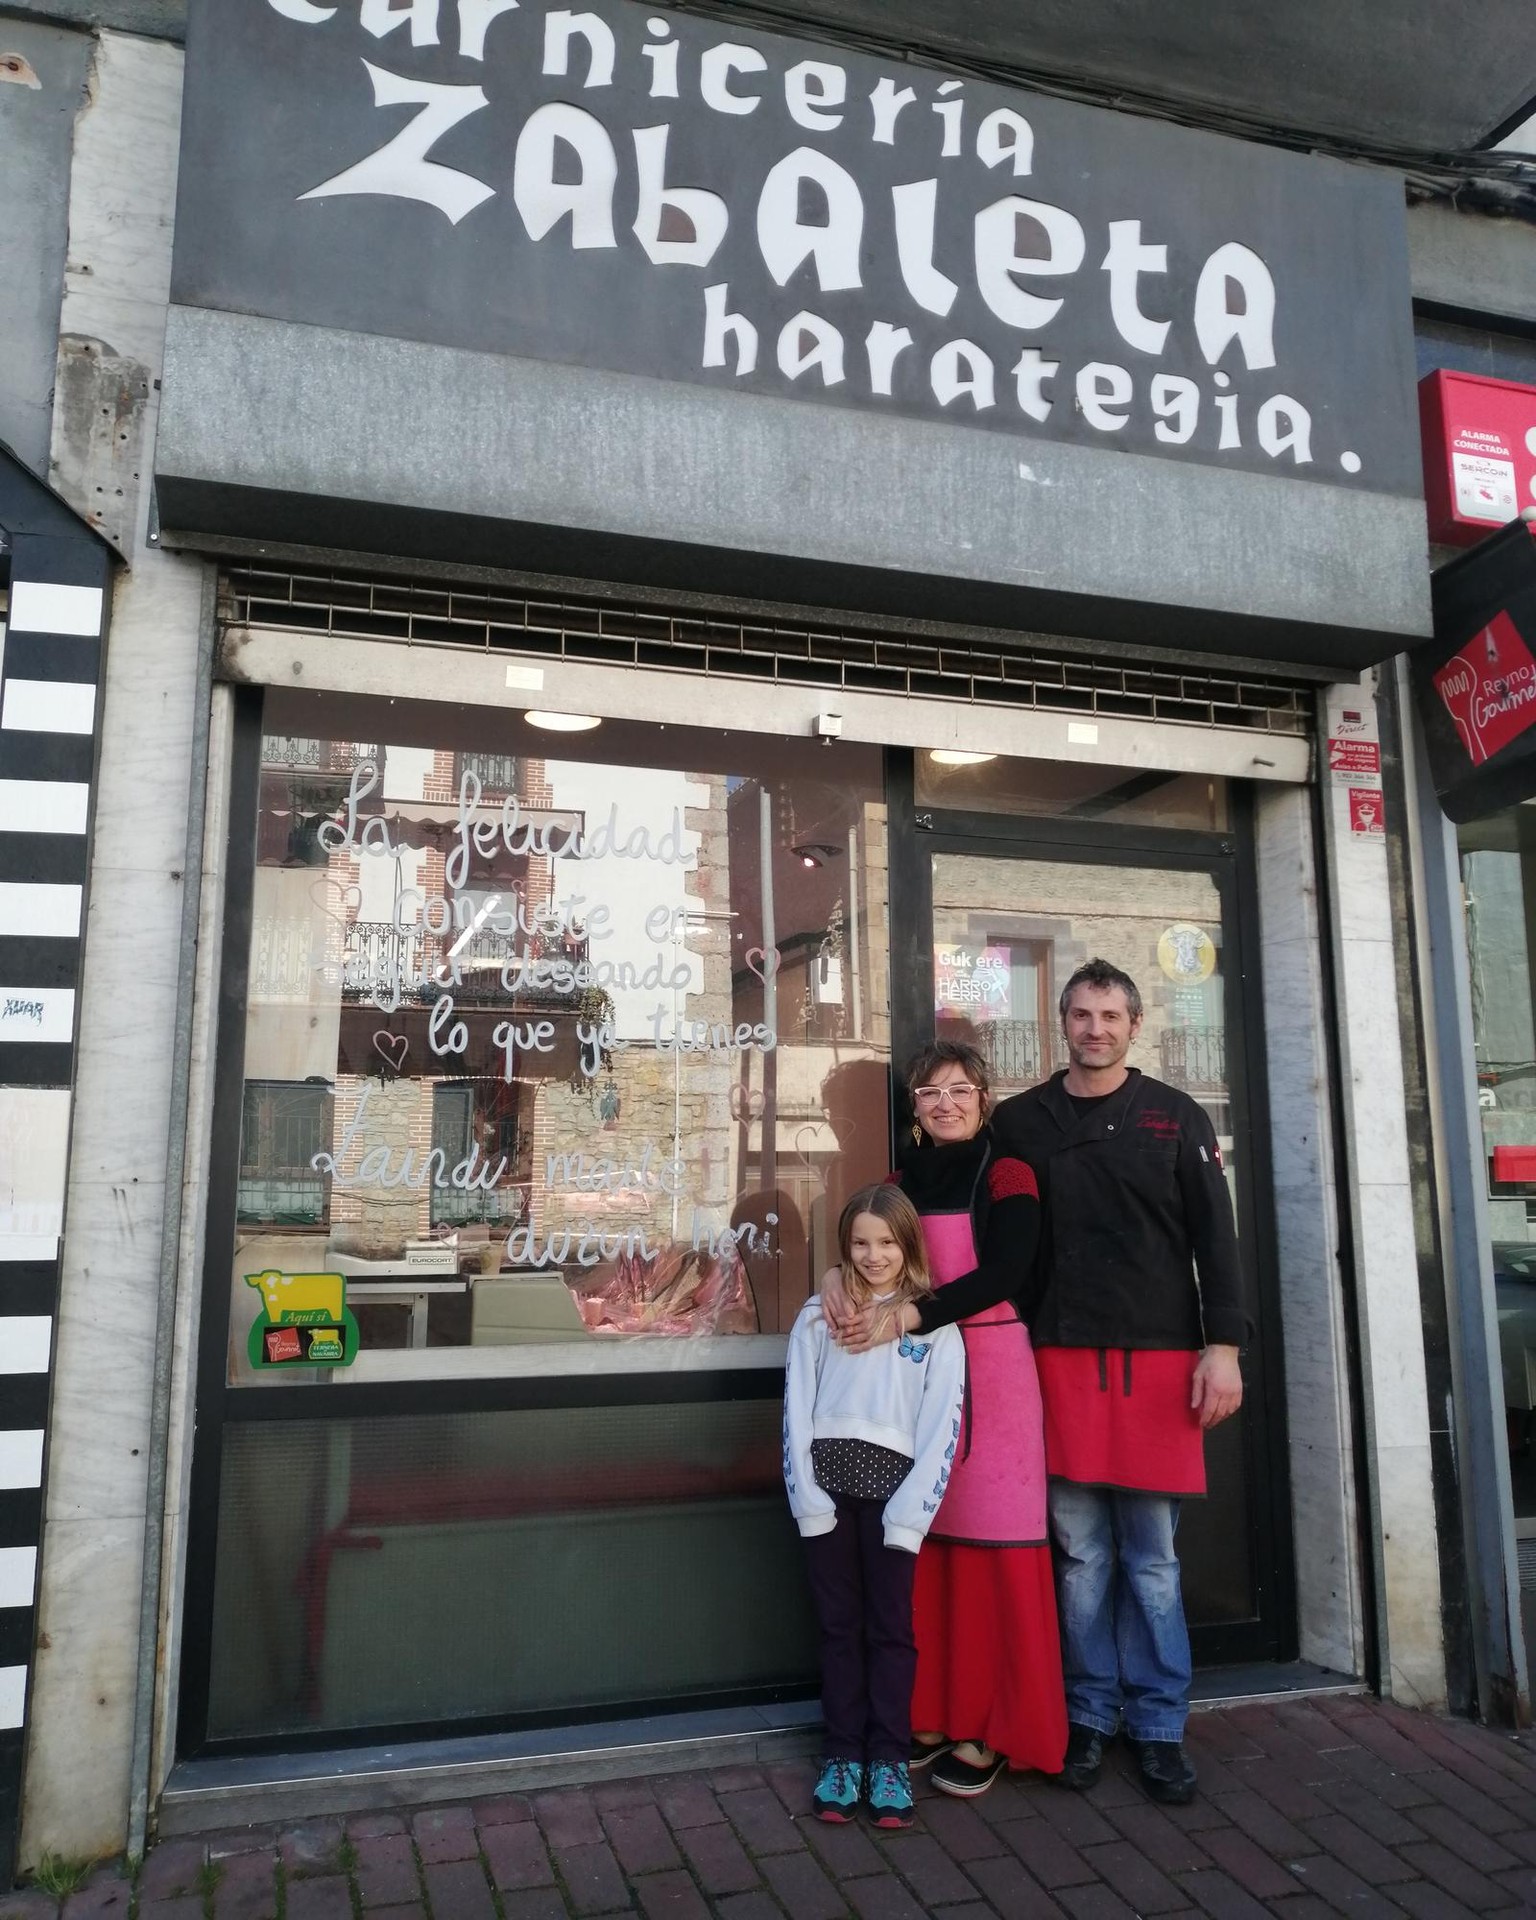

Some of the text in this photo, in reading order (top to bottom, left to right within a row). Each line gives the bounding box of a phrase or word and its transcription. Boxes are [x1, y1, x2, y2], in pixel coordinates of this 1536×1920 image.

[1453, 439, 1510, 456] CONECTADA
[1460, 429, 1501, 444] ALARMA
[1482, 666, 1529, 698] Reyno
[1333, 740, 1376, 753] Alarma
[317, 758, 695, 889] La felicidad
[645, 903, 690, 944] en
[500, 943, 693, 994] deseando
[938, 950, 1003, 968] Guk ere
[428, 994, 777, 1083] lo que ya tienes
